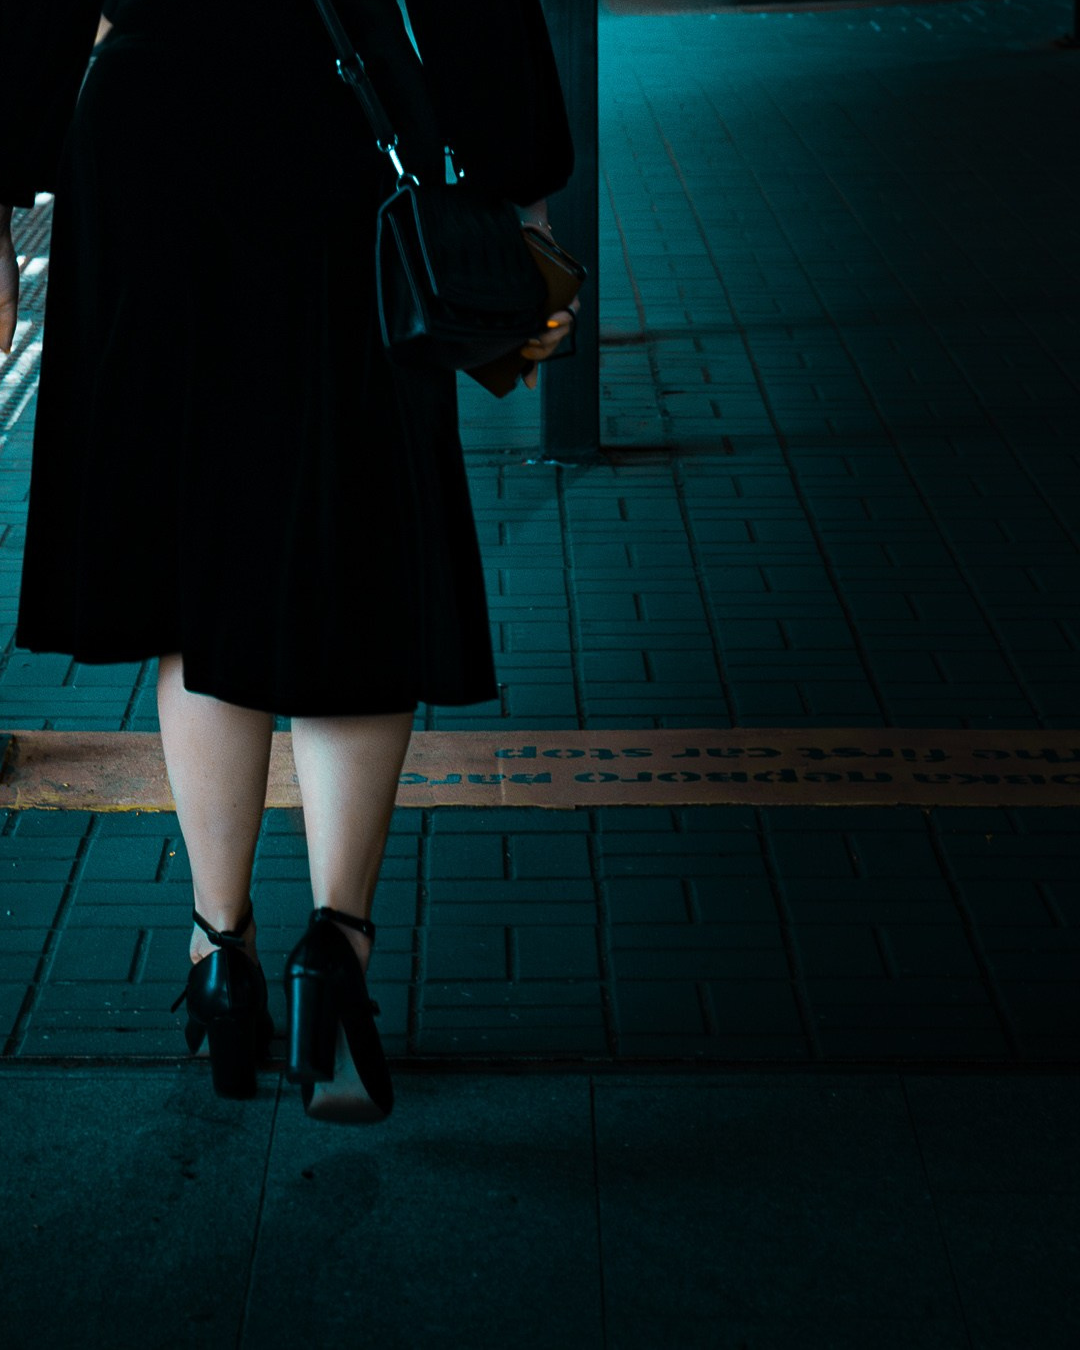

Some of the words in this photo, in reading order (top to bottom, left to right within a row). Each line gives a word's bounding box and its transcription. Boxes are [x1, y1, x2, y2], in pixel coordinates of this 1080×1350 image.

[494, 745, 653, 760] stop
[672, 747, 781, 758] car
[796, 747, 952, 762] first
[397, 772, 552, 785] ваго
[575, 768, 893, 784] первого
